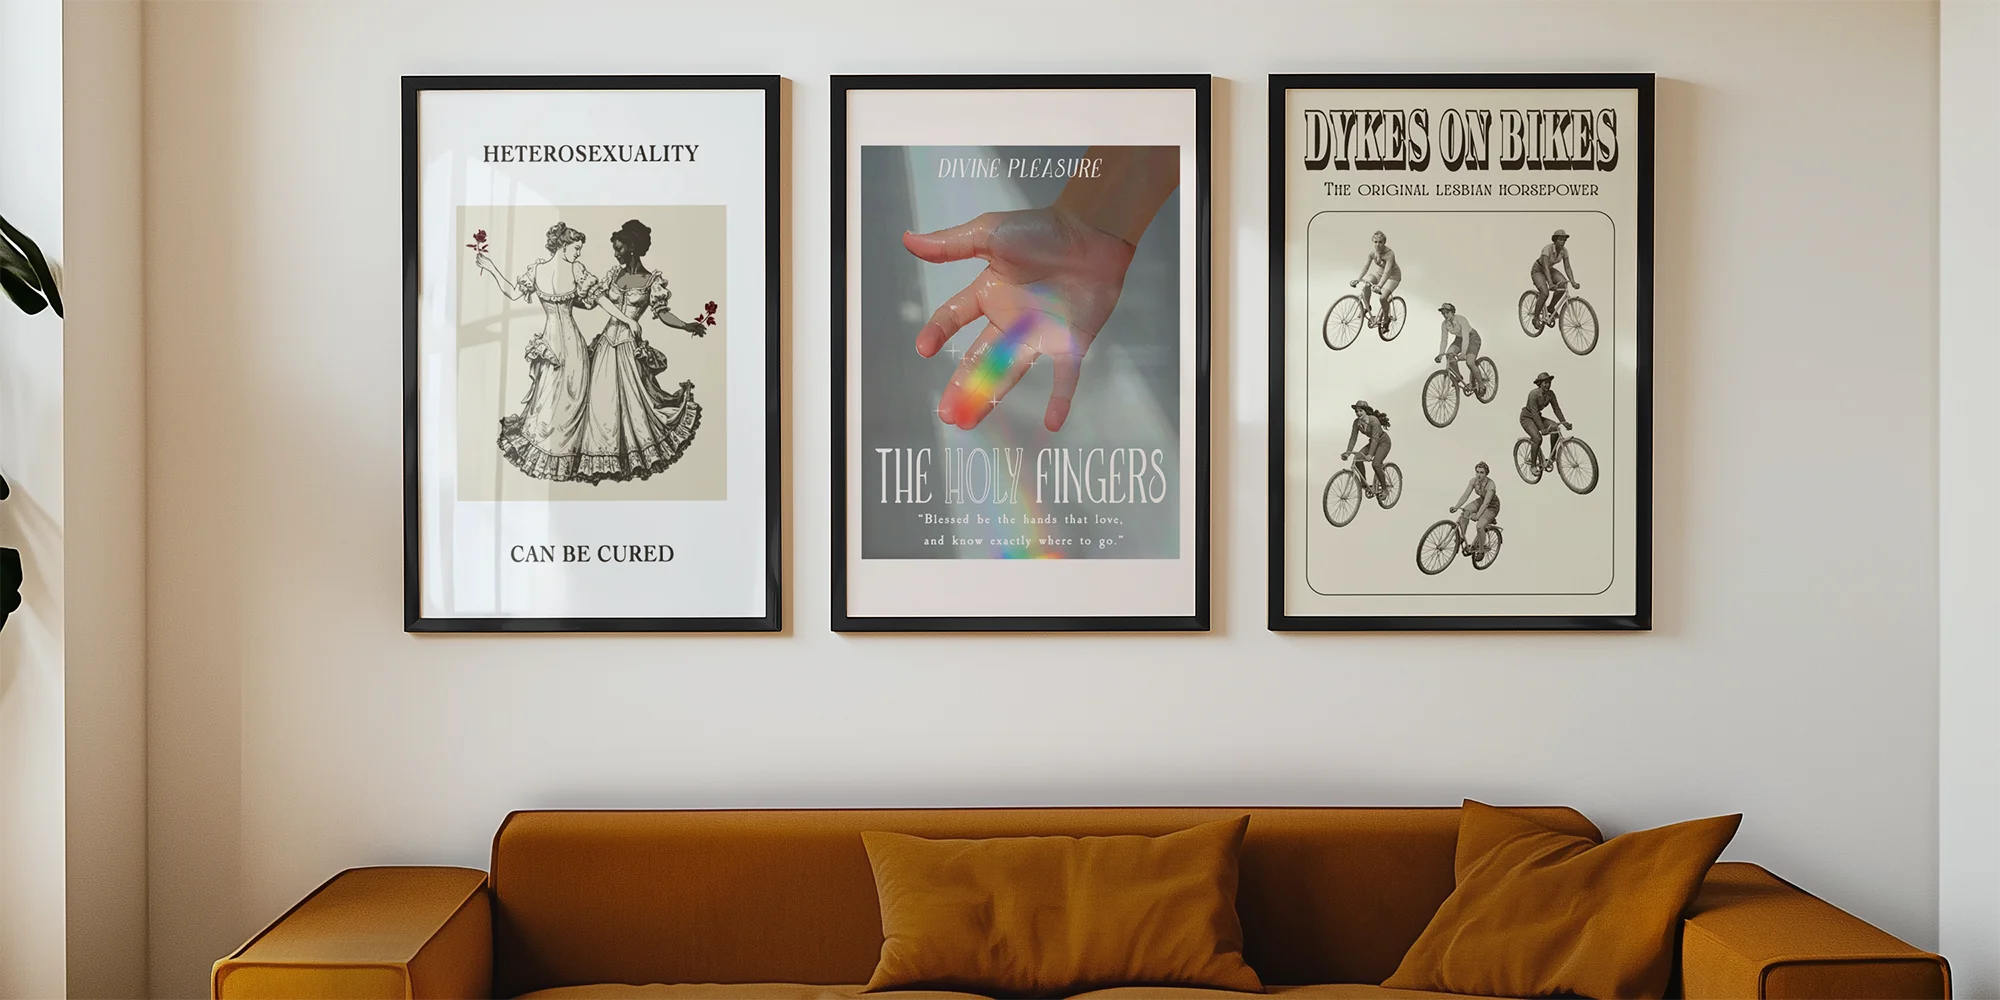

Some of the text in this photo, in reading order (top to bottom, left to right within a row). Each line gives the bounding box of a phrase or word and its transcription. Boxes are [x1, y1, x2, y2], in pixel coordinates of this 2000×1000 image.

[1304, 108, 1619, 172] DYKES ON BIKES
[483, 145, 700, 163] HETEROSEXUALITY
[938, 158, 1103, 178] DIVINE PLEASURE
[875, 447, 1167, 504] THE HOLY FINGERS
[918, 513, 1123, 526] “Blessed be the hands that love,
[924, 535, 1124, 549] and know exactly where to go.”
[510, 545, 675, 563] CAN BE CURED
